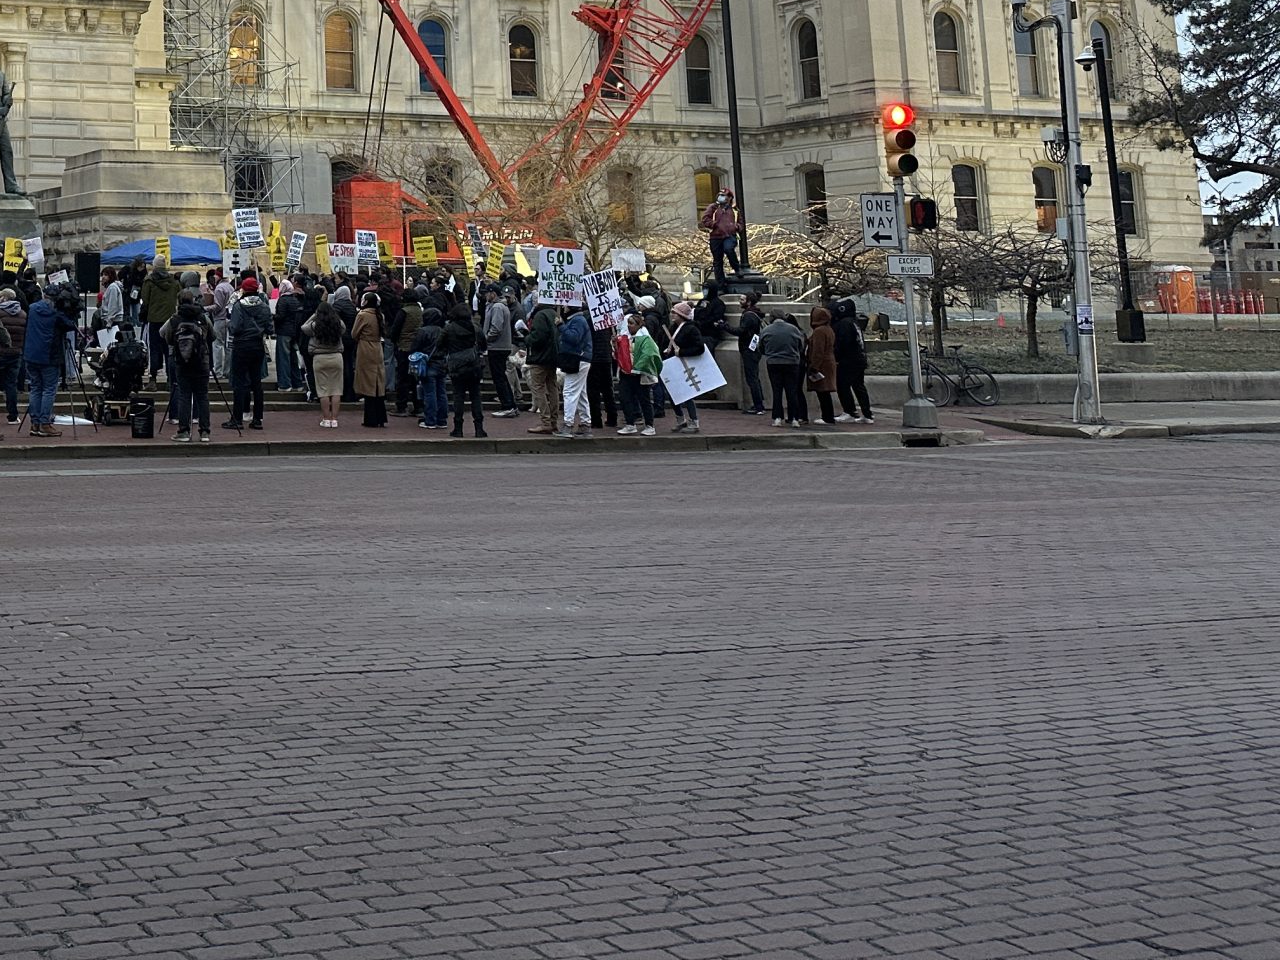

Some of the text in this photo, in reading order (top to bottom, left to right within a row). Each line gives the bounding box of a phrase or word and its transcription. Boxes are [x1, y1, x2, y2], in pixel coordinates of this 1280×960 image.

[865, 199, 892, 212] ONE
[865, 216, 894, 228] WAY
[328, 244, 356, 258] WE SPEAK
[546, 250, 574, 265] GOD
[552, 264, 565, 273] IS
[900, 266, 921, 274] BUSES
[541, 272, 583, 283] WATCHING
[583, 270, 617, 297] NOBODY
[547, 281, 575, 291] RAIDS
[539, 289, 553, 298] ARE
[595, 293, 610, 307] IS
